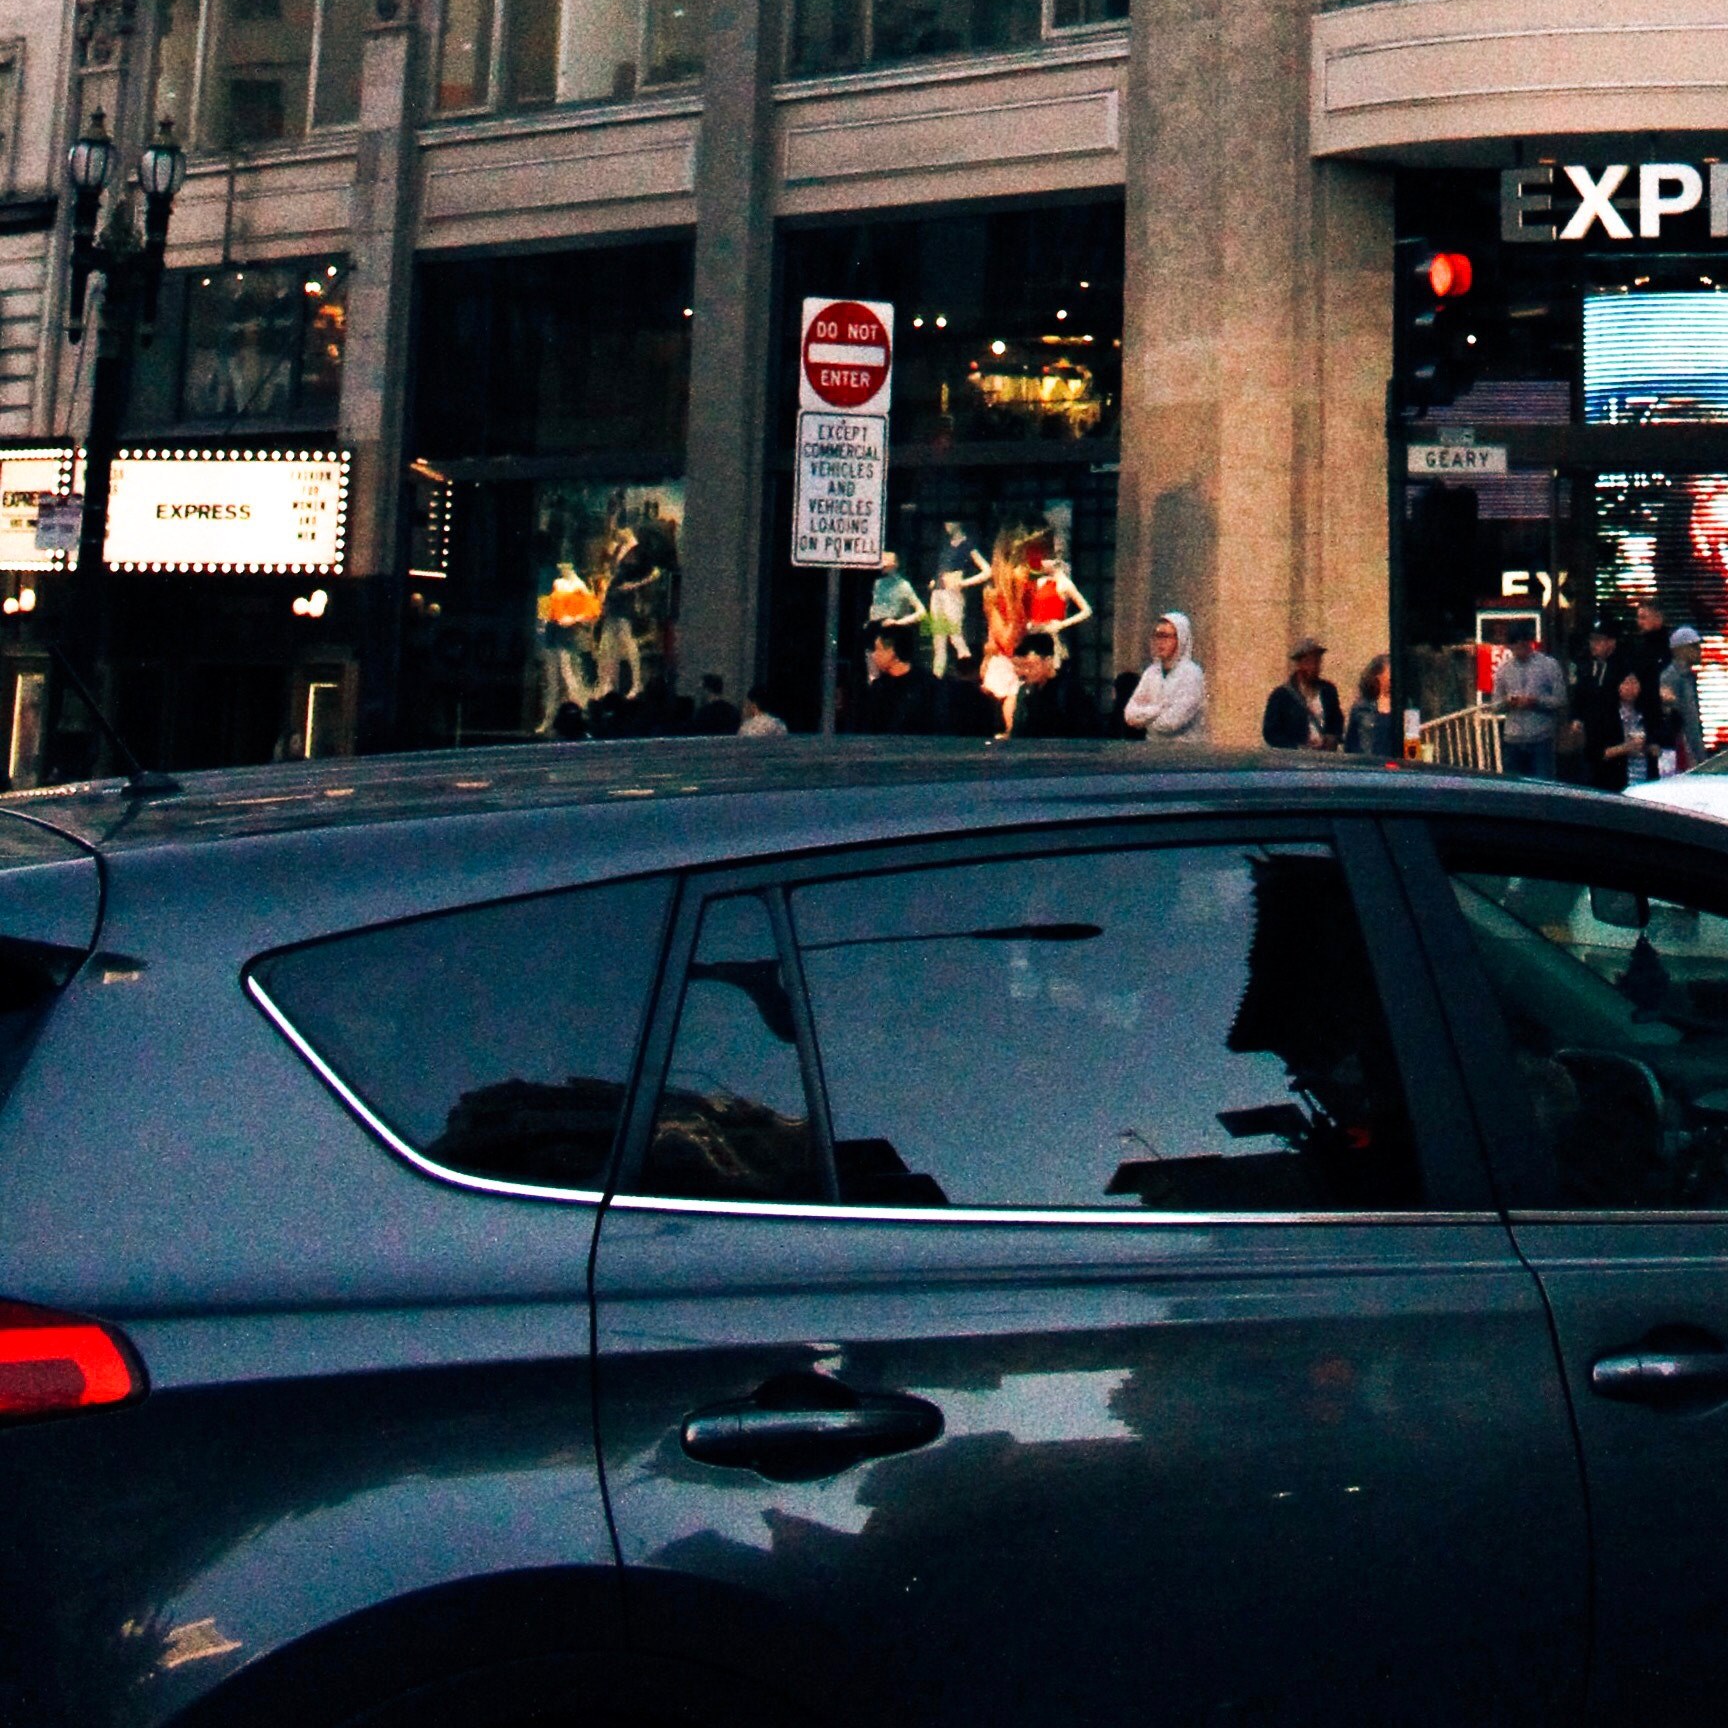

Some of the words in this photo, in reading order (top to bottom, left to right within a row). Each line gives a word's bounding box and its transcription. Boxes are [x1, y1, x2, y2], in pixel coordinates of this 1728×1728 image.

[817, 321, 838, 340] DO
[847, 323, 879, 341] NOT
[820, 369, 871, 389] ENTER
[818, 424, 868, 442] EXCEPT
[803, 442, 881, 461] COMMERCIAL
[1425, 449, 1489, 468] GEARY
[810, 461, 874, 479] VEHICLES
[828, 480, 857, 497] AND
[155, 503, 251, 521] EXPRESS
[808, 498, 874, 516] VEHICLES
[809, 517, 869, 535] LOADING
[799, 535, 818, 552] ON
[824, 536, 877, 554] POWELL
